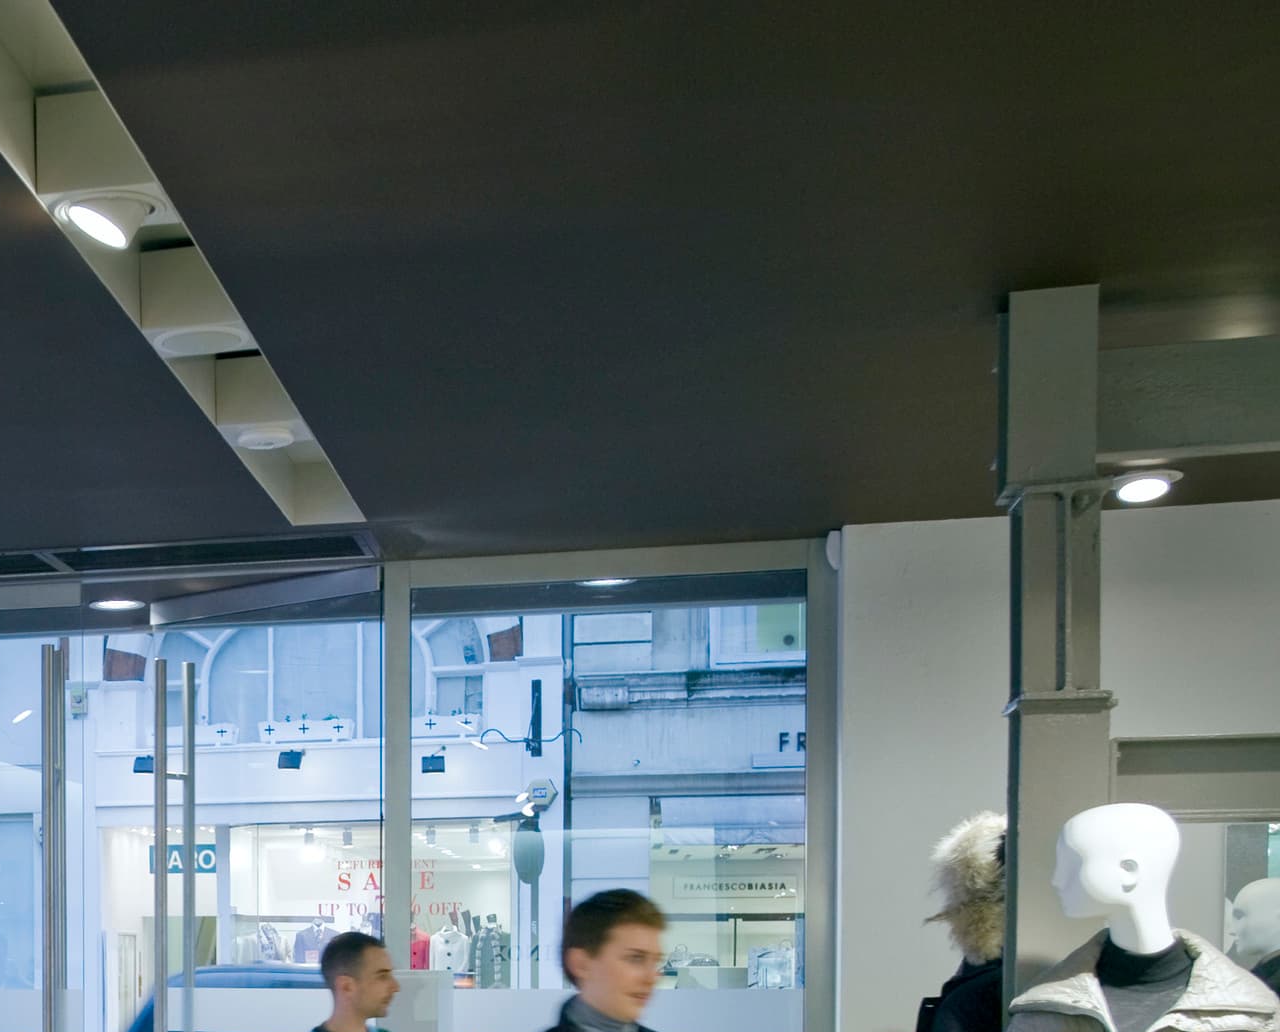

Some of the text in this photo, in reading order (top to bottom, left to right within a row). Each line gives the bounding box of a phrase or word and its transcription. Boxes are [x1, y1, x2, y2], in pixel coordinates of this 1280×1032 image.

[337, 871, 434, 891] SAE
[318, 903, 340, 916] UP
[346, 902, 368, 916] TO
[429, 901, 463, 916] OFF
